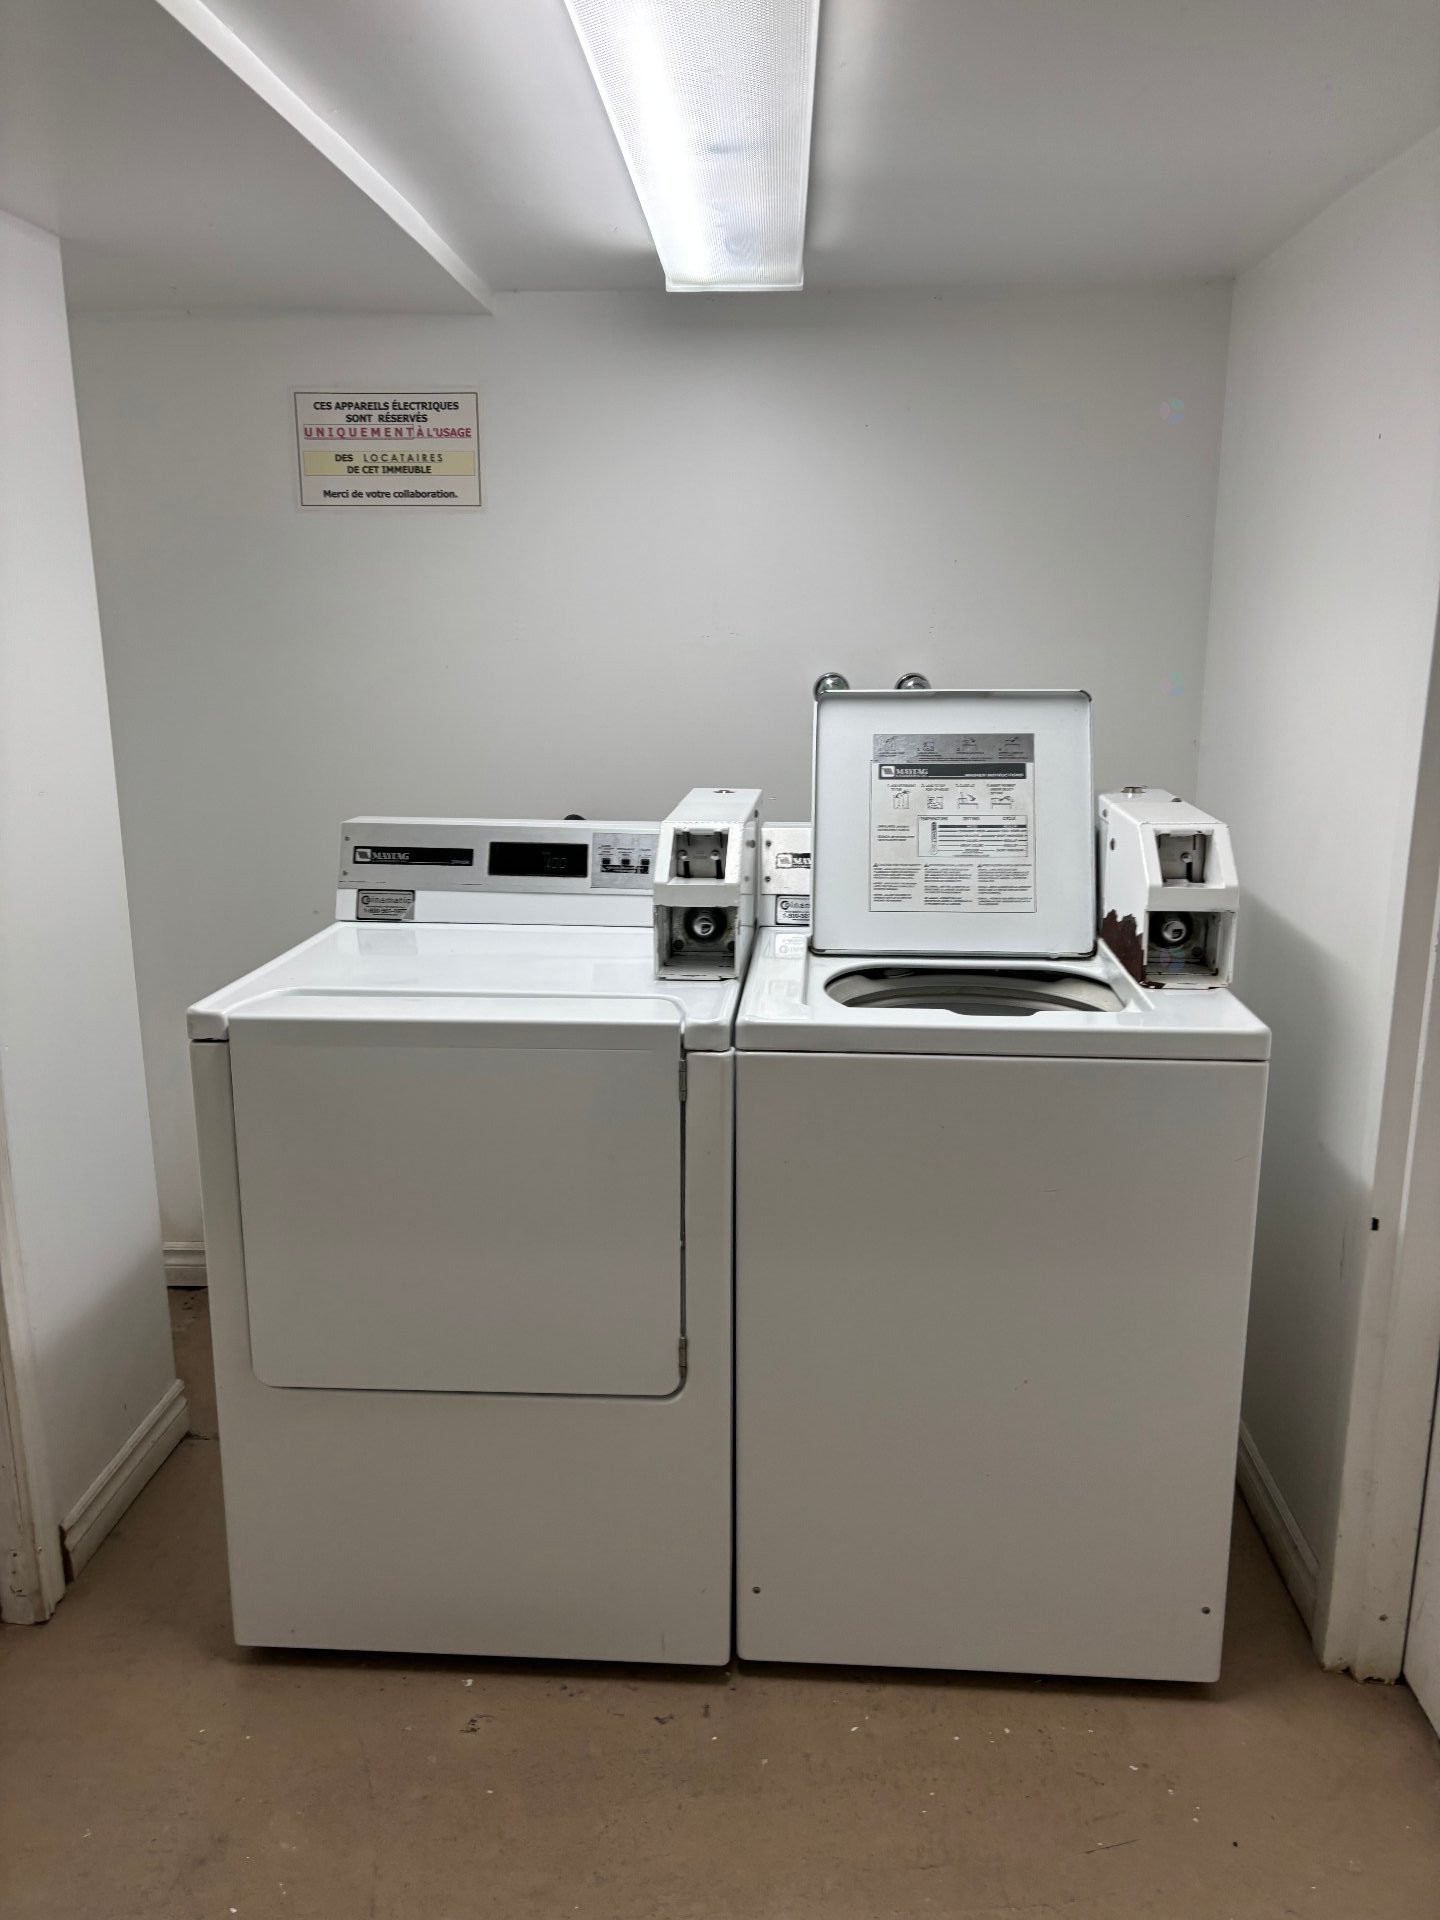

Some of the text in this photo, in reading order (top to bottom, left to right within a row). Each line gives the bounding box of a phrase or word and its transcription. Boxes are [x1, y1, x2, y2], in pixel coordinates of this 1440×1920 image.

[313, 399, 459, 411] CES APPAREILS ÉLECTRIQUES
[345, 412, 428, 423] SONT RÉSERVÉS
[304, 425, 472, 438] UNIQUEMENT À L'USAGE
[335, 453, 443, 463] DES LOCATAIRES
[347, 465, 432, 474] DE CET IMMEUBLE
[323, 489, 458, 498] Merci de votre collaboration.
[371, 852, 410, 860] MAYTAG
